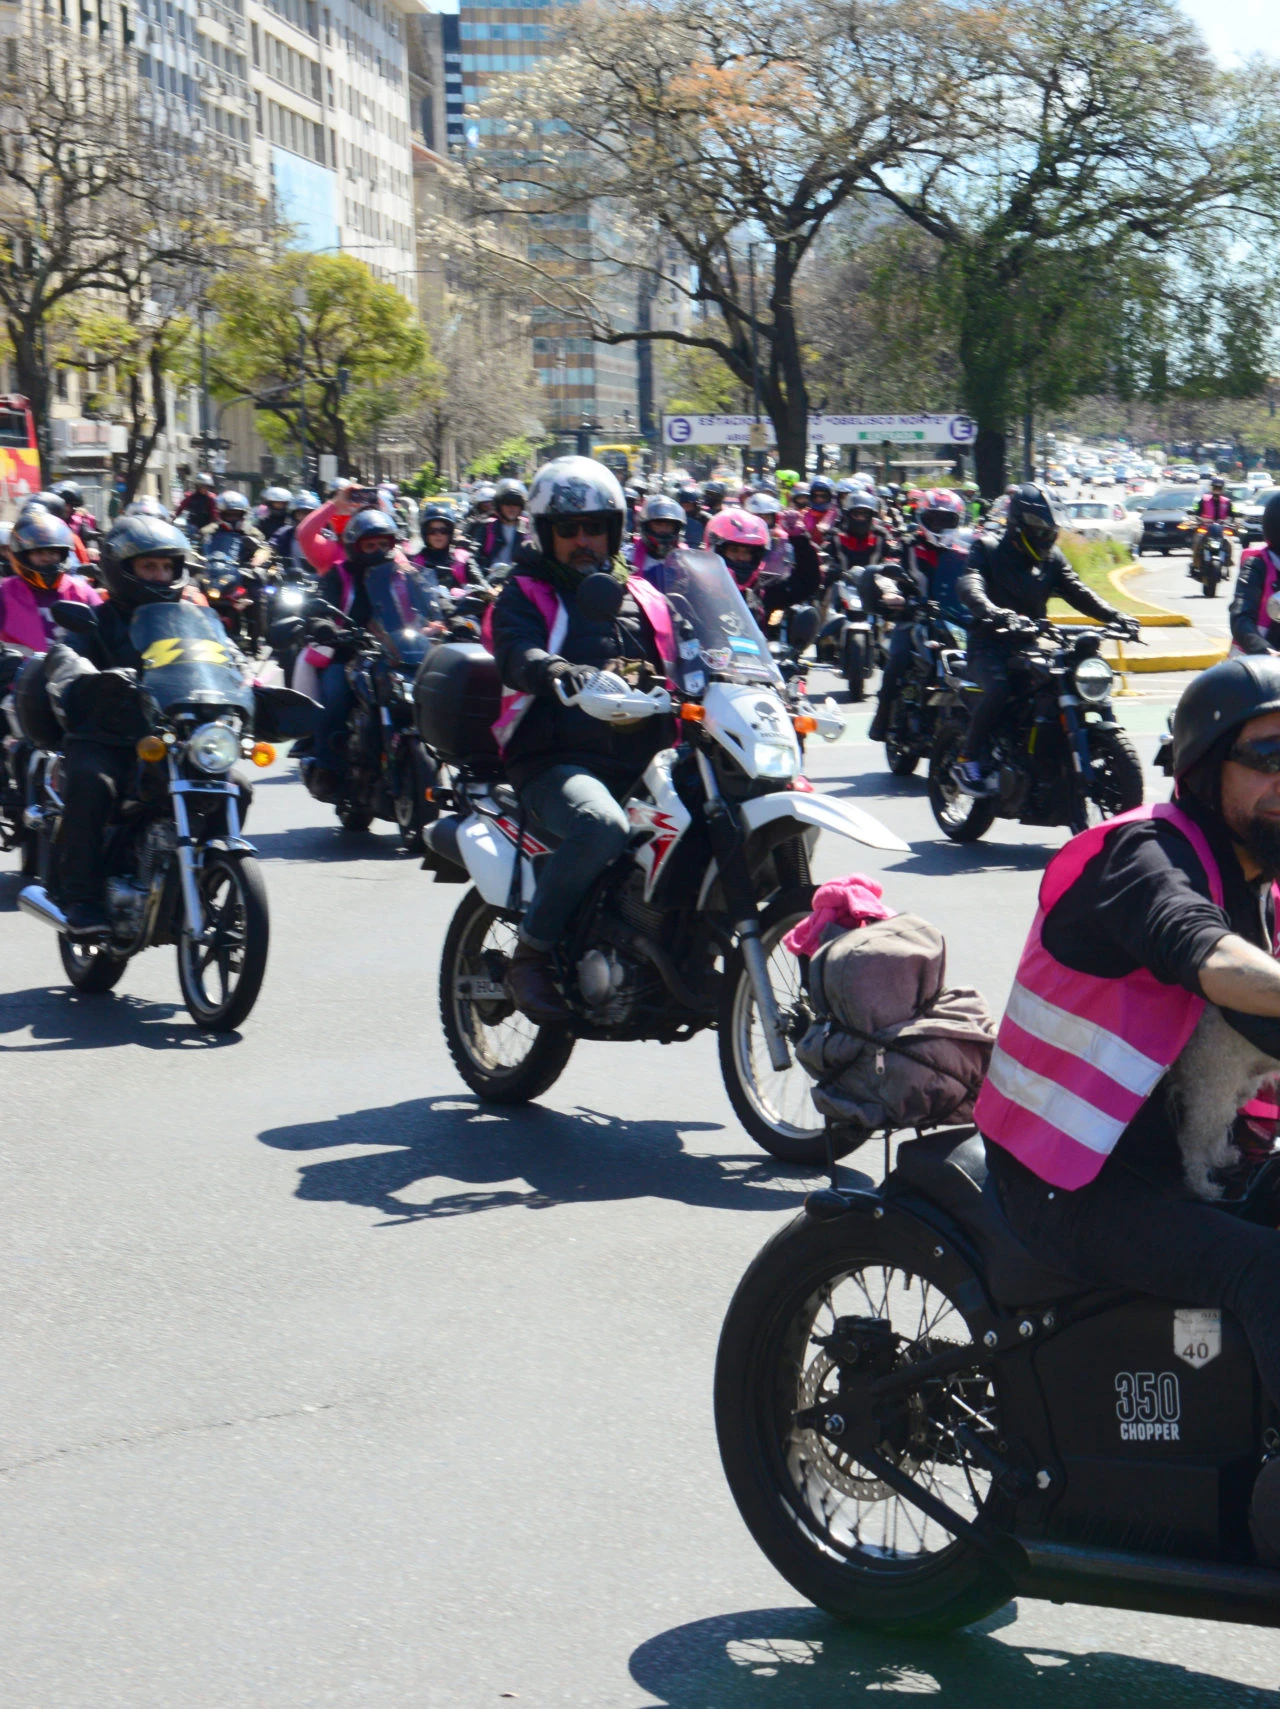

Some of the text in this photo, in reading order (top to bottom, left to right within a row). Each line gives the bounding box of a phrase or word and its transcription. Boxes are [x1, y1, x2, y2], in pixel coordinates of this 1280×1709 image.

[1182, 1342, 1209, 1359] 40
[1114, 1371, 1181, 1423] 350
[1119, 1422, 1181, 1441] CHOPPER
